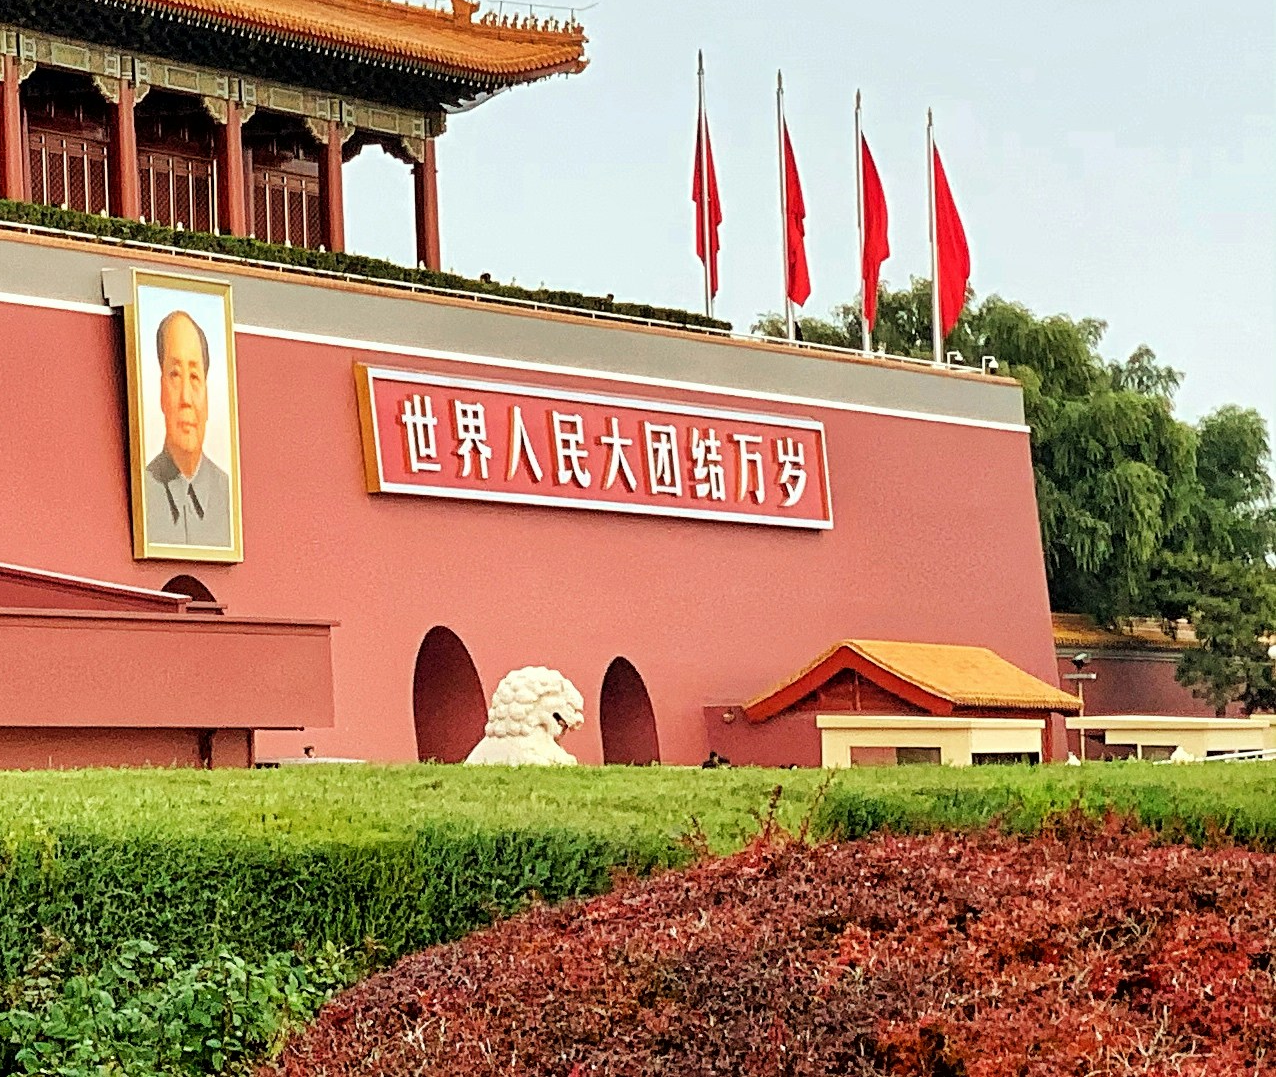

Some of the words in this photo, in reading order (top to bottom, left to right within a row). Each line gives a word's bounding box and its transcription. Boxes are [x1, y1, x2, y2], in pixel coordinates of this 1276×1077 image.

[401, 394, 808, 507] 世界人民大团结万岁
